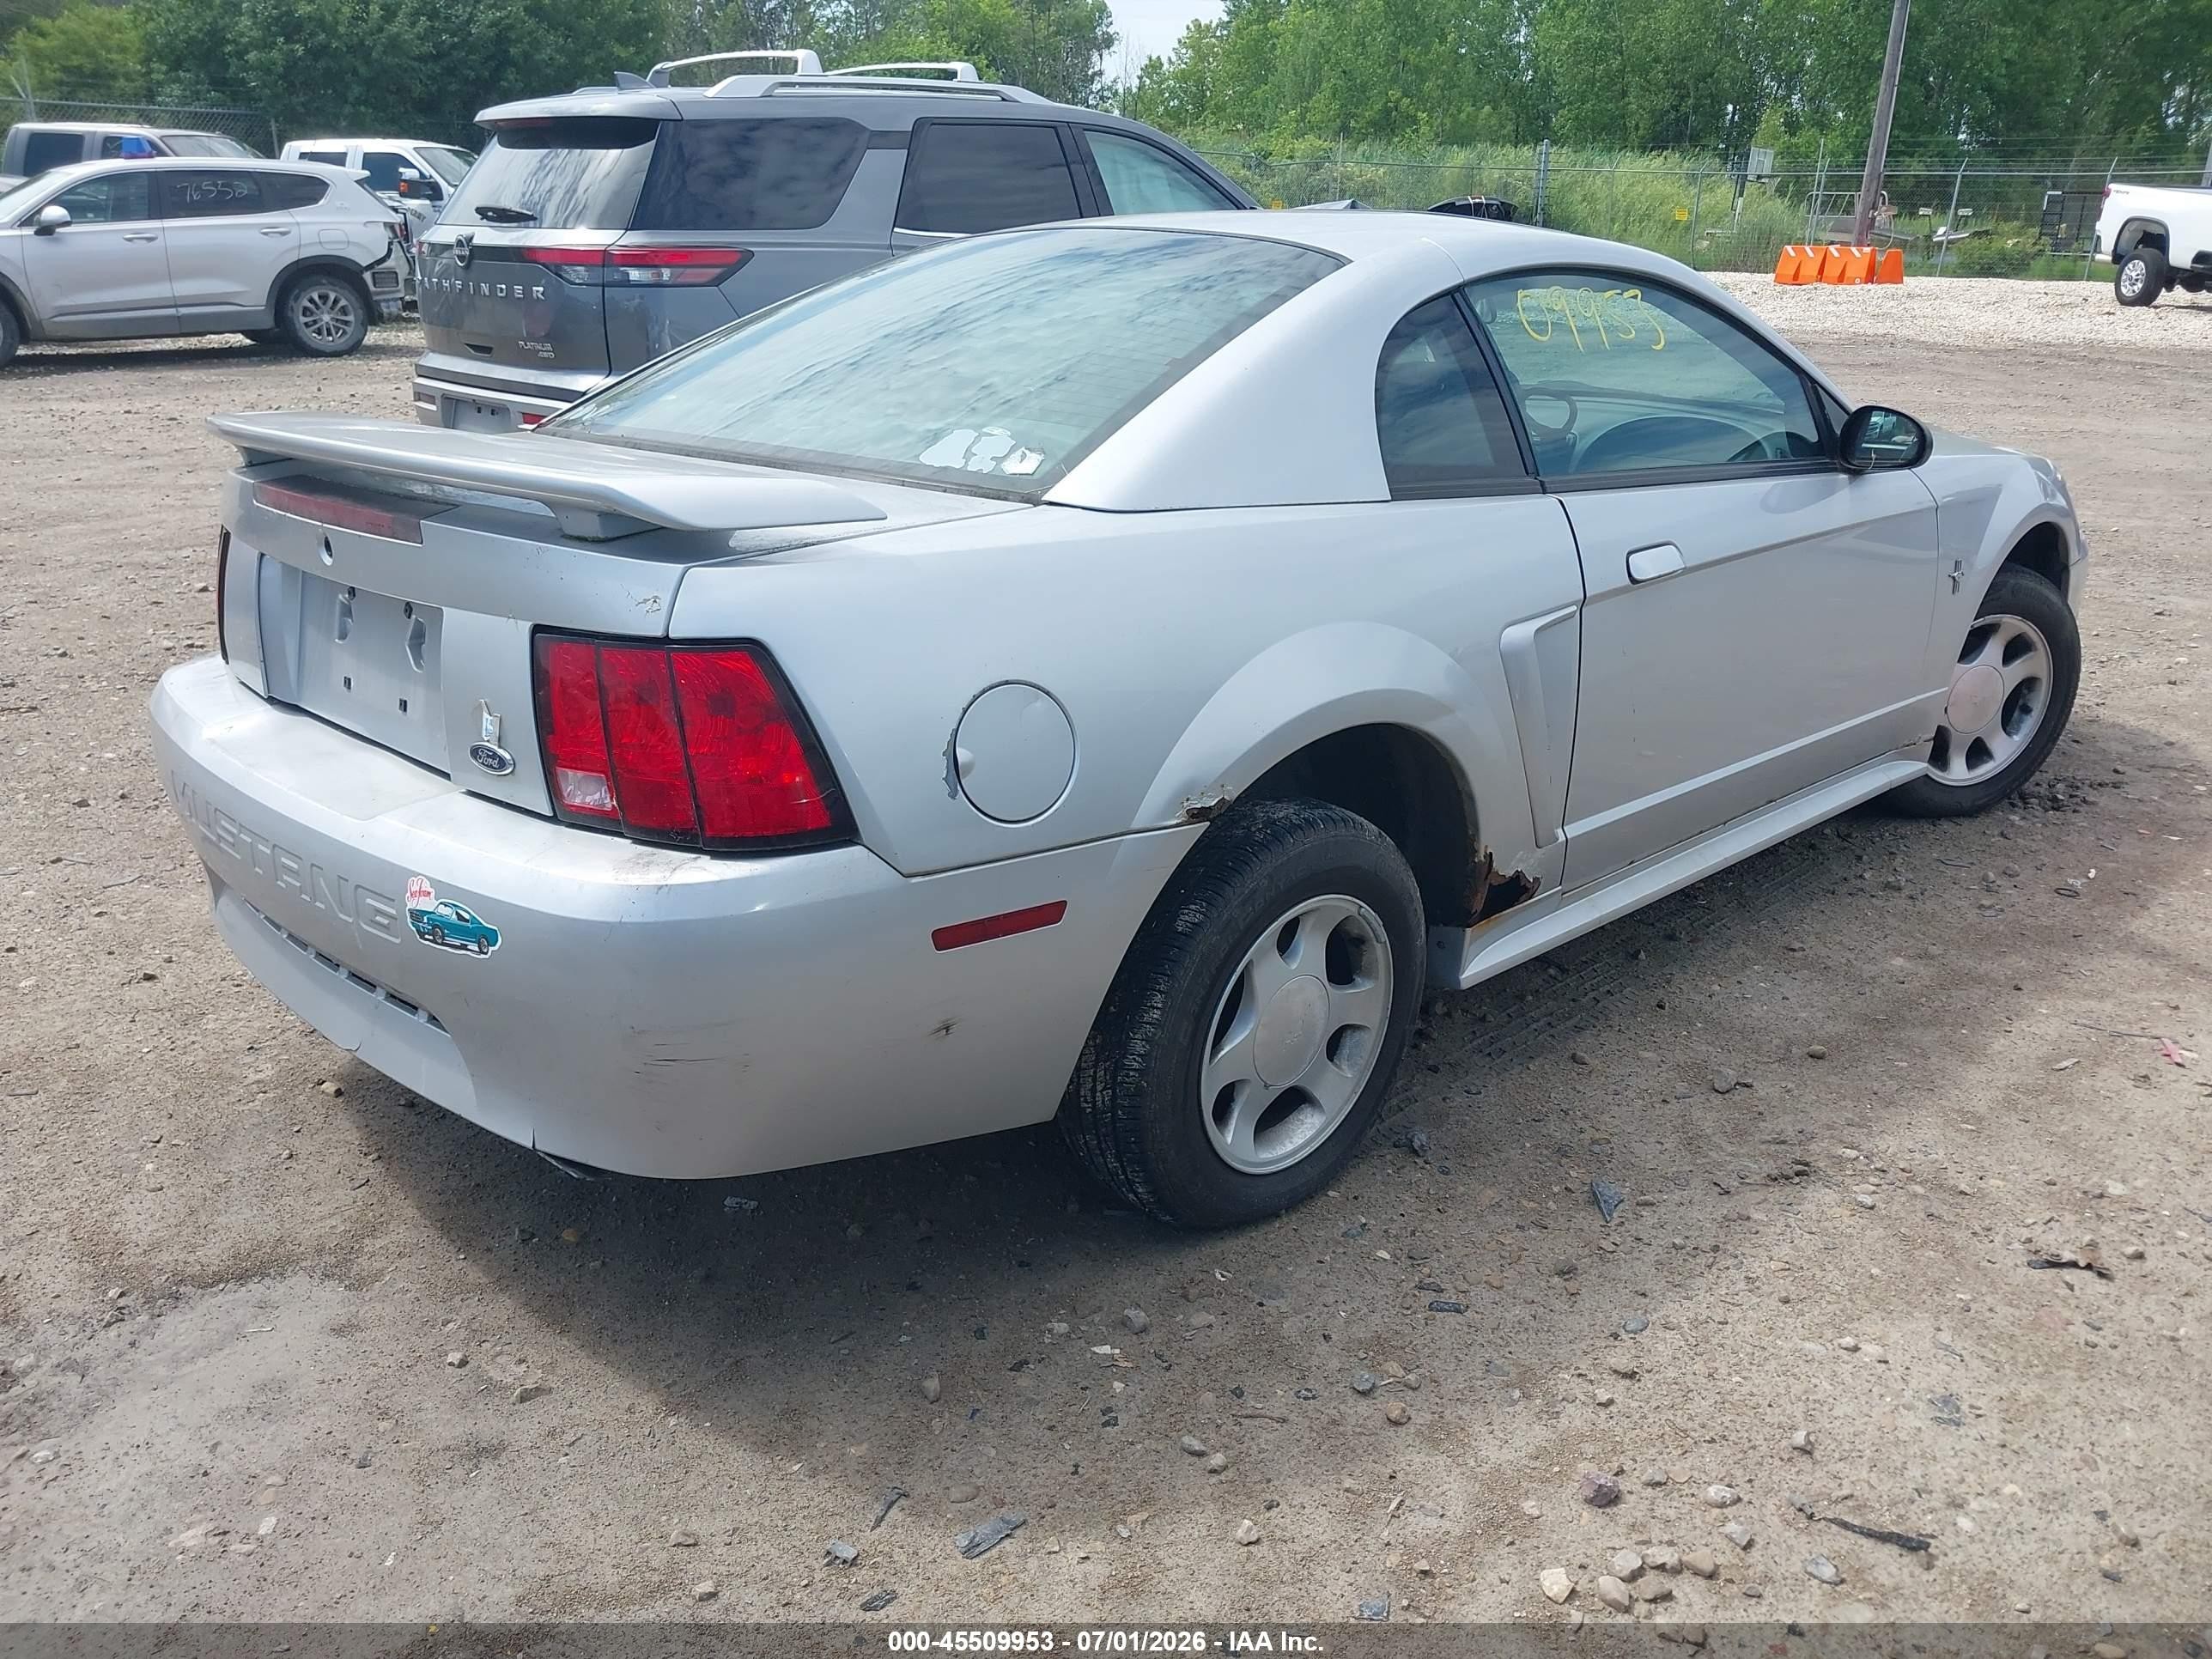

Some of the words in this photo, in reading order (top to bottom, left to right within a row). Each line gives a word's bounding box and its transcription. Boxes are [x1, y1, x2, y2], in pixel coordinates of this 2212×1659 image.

[176, 180, 248, 203] 76552
[518, 341, 554, 352] PLATINUM
[477, 748, 501, 769] Ford
[170, 769, 402, 944] MUSTANG
